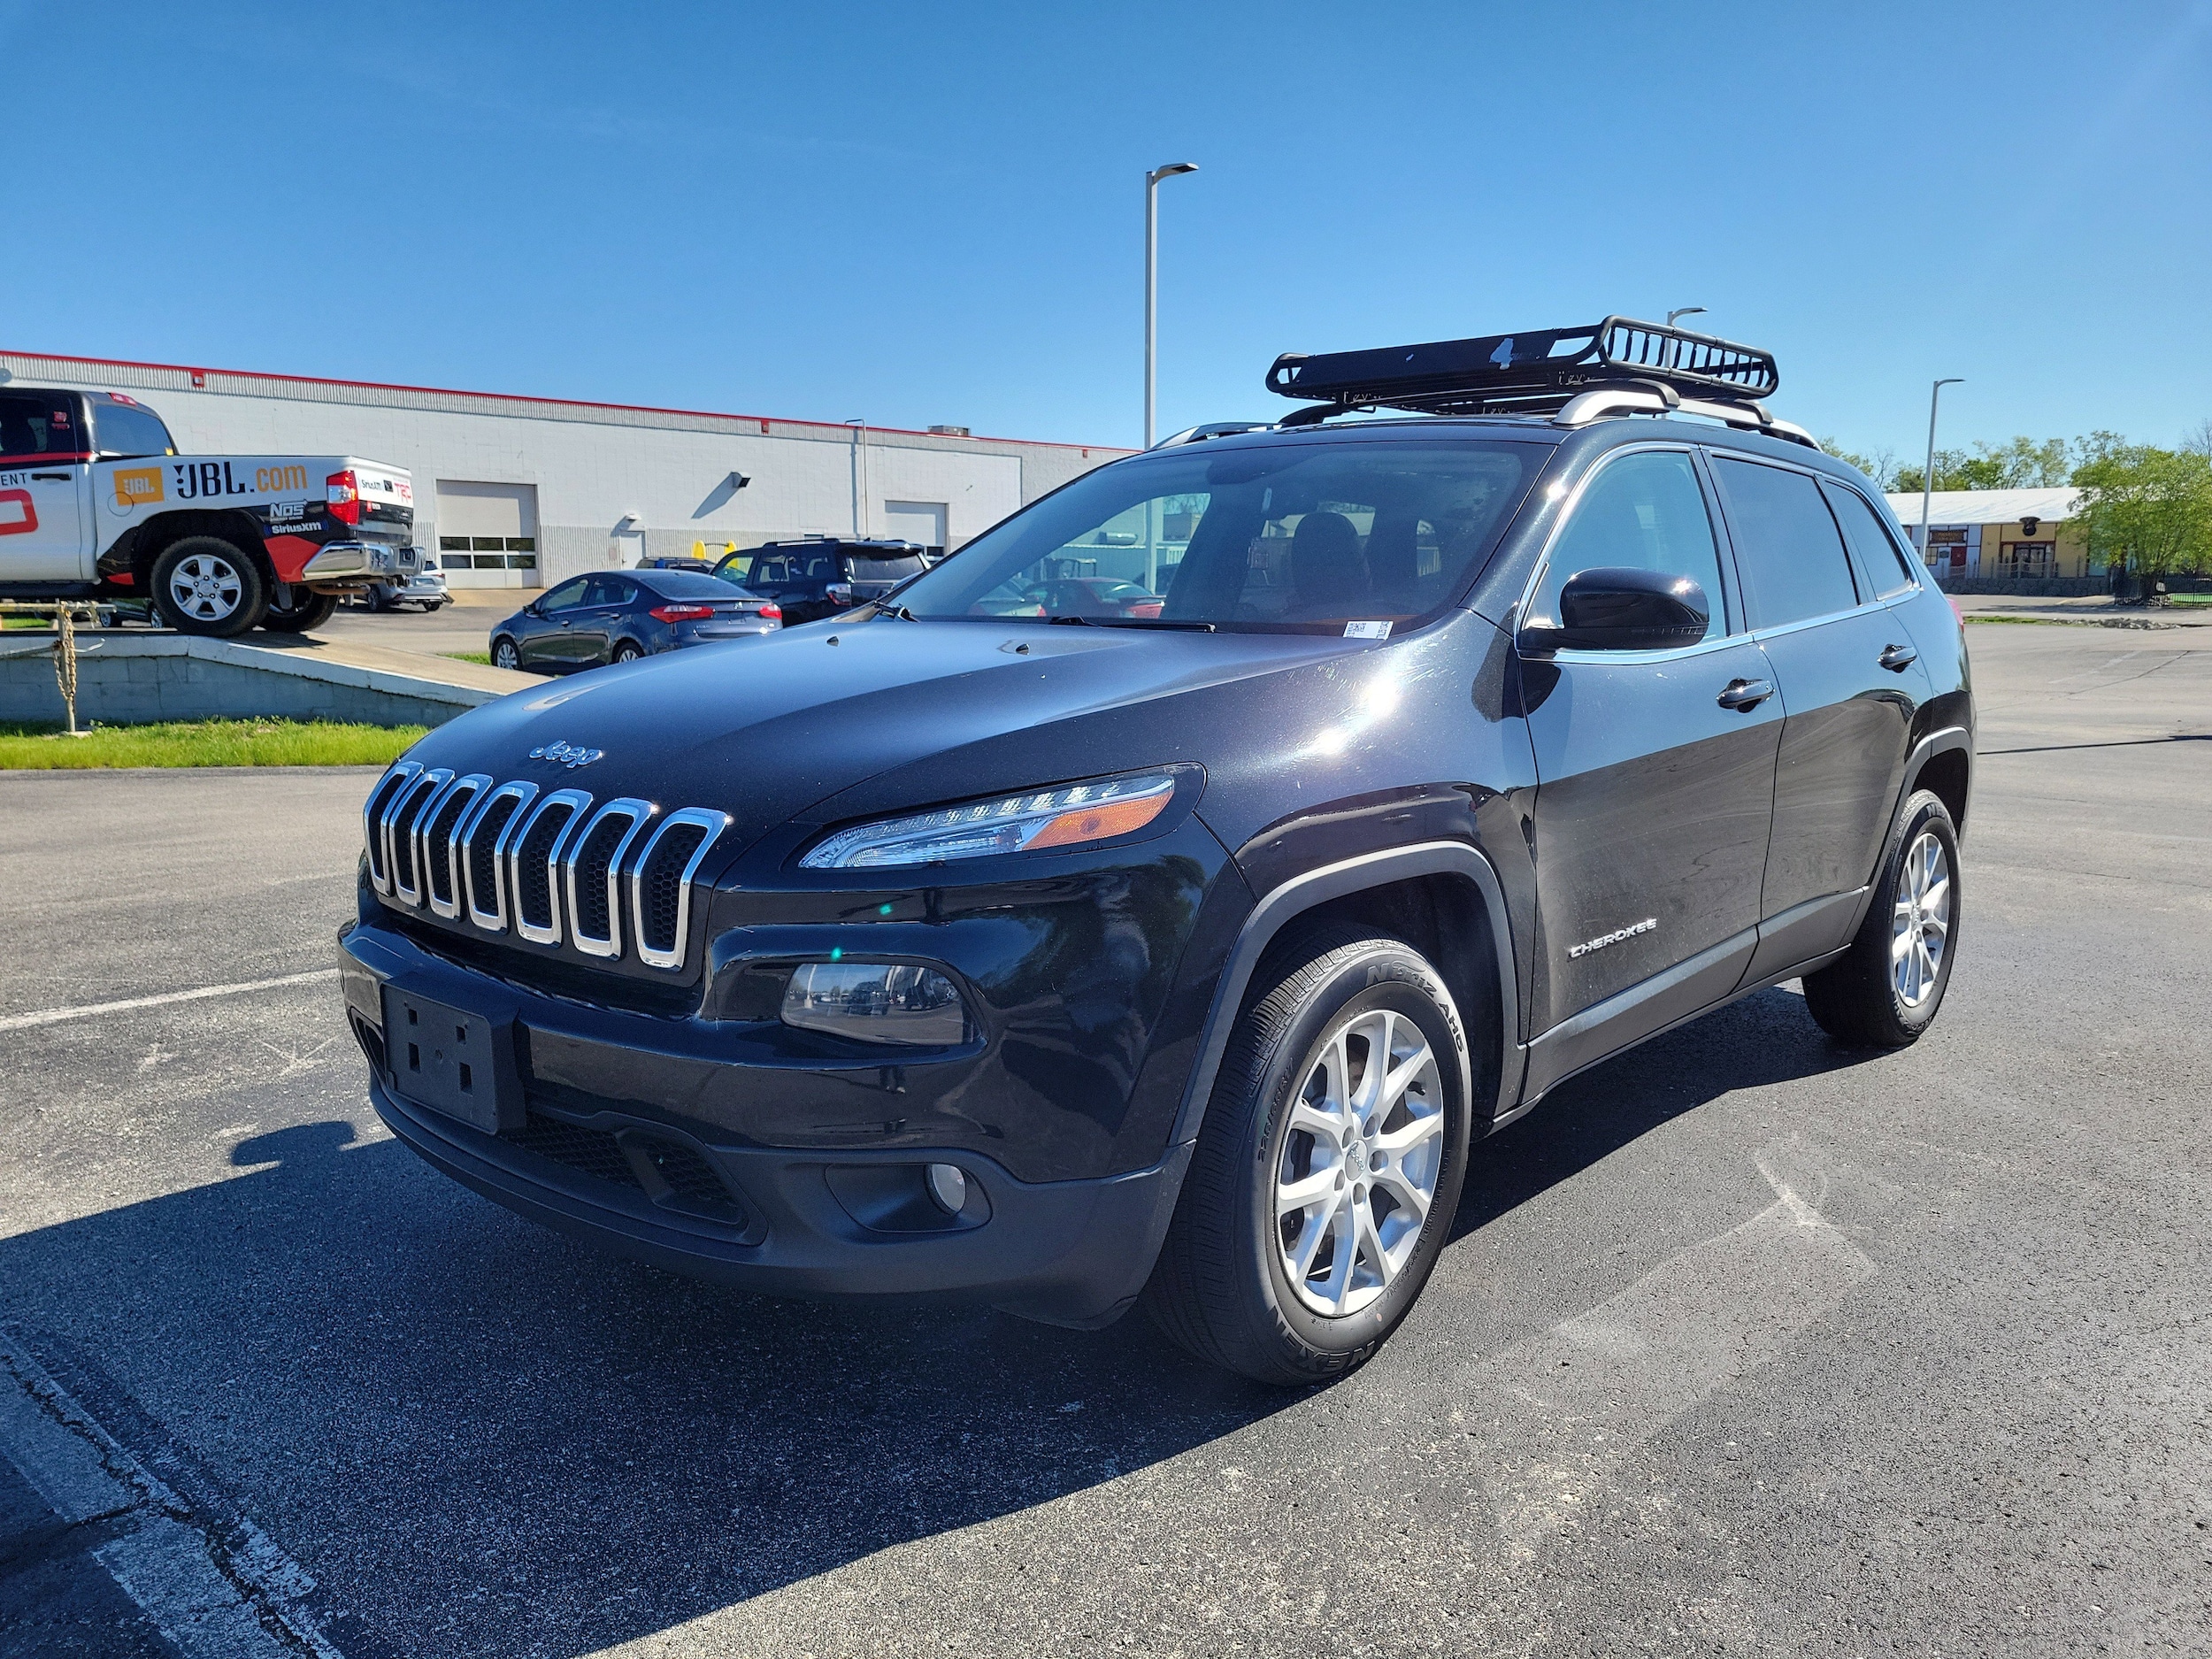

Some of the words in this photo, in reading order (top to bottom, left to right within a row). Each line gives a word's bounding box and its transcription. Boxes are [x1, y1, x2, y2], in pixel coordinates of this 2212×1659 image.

[123, 477, 155, 495] JBL
[270, 500, 307, 517] NOS
[529, 740, 603, 769] Jeep
[1570, 918, 1657, 958] CHEROKEE
